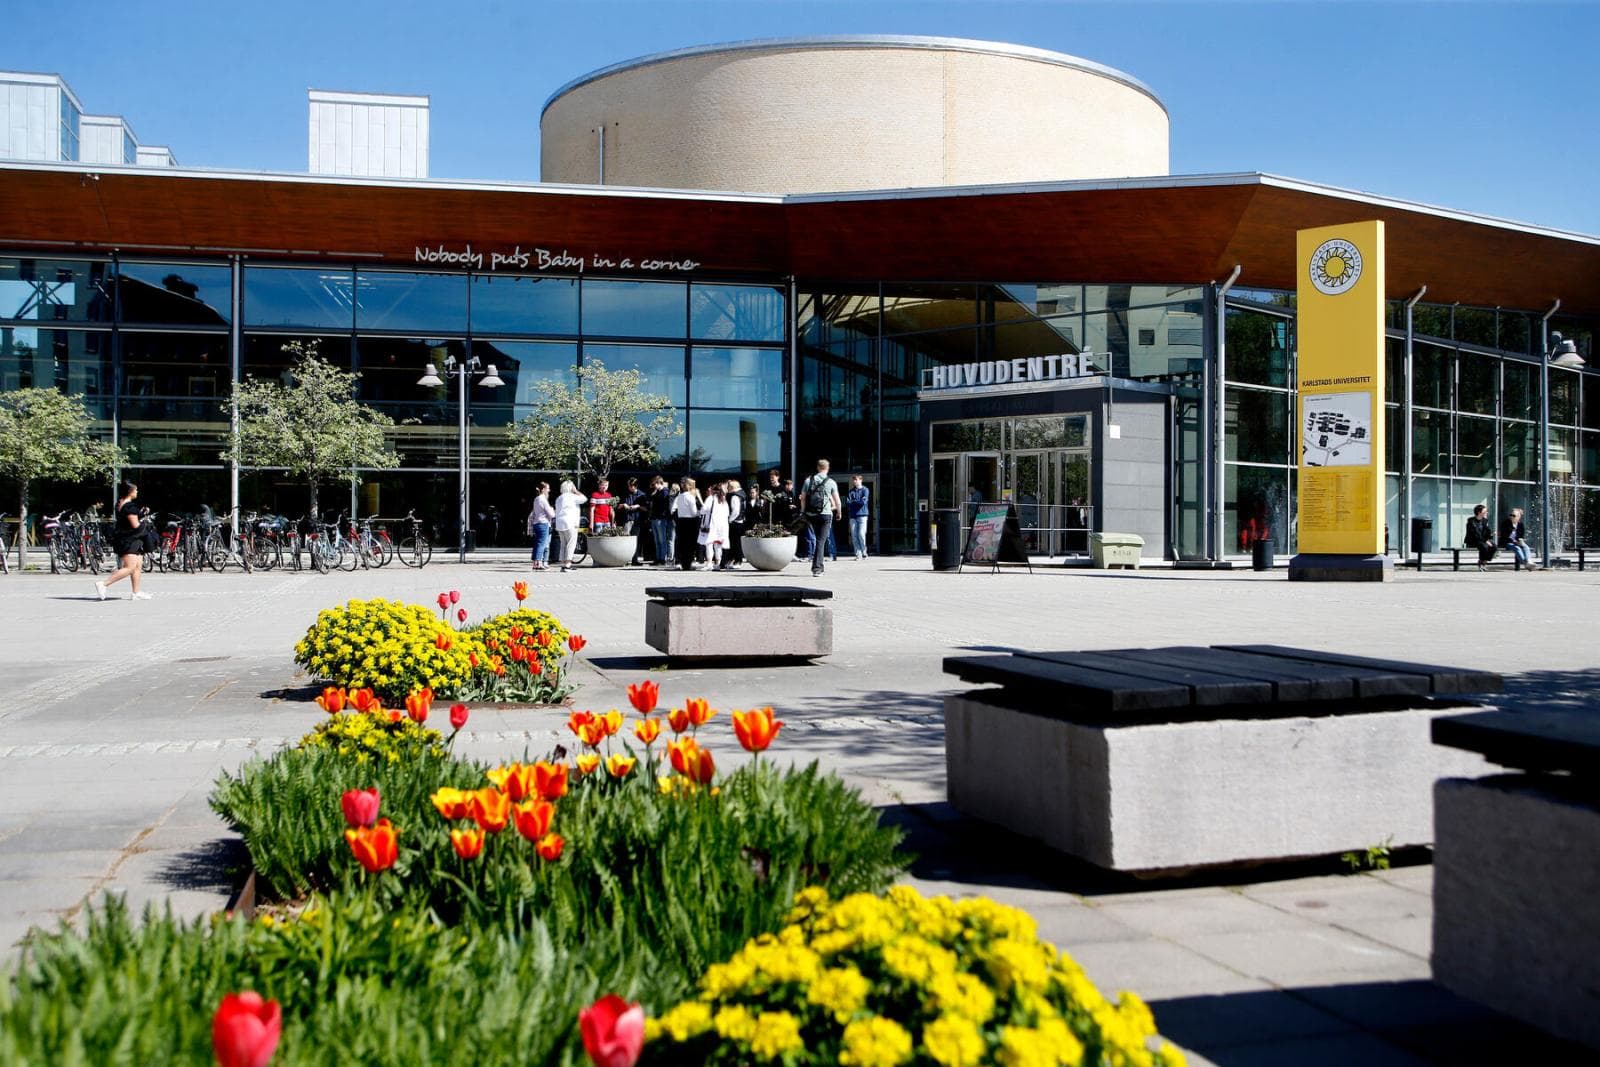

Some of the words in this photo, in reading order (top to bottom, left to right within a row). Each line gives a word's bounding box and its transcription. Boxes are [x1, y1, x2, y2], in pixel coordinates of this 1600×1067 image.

[415, 244, 483, 270] Nobody
[490, 245, 530, 270] puts
[534, 248, 584, 273] Baby
[593, 252, 616, 268] in
[619, 258, 635, 269] a
[640, 259, 700, 271] corner
[932, 345, 1094, 389] HUVUDENTRÉ
[1302, 379, 1332, 387] KARLSTADS
[1333, 376, 1371, 385] UNIVERSITET
